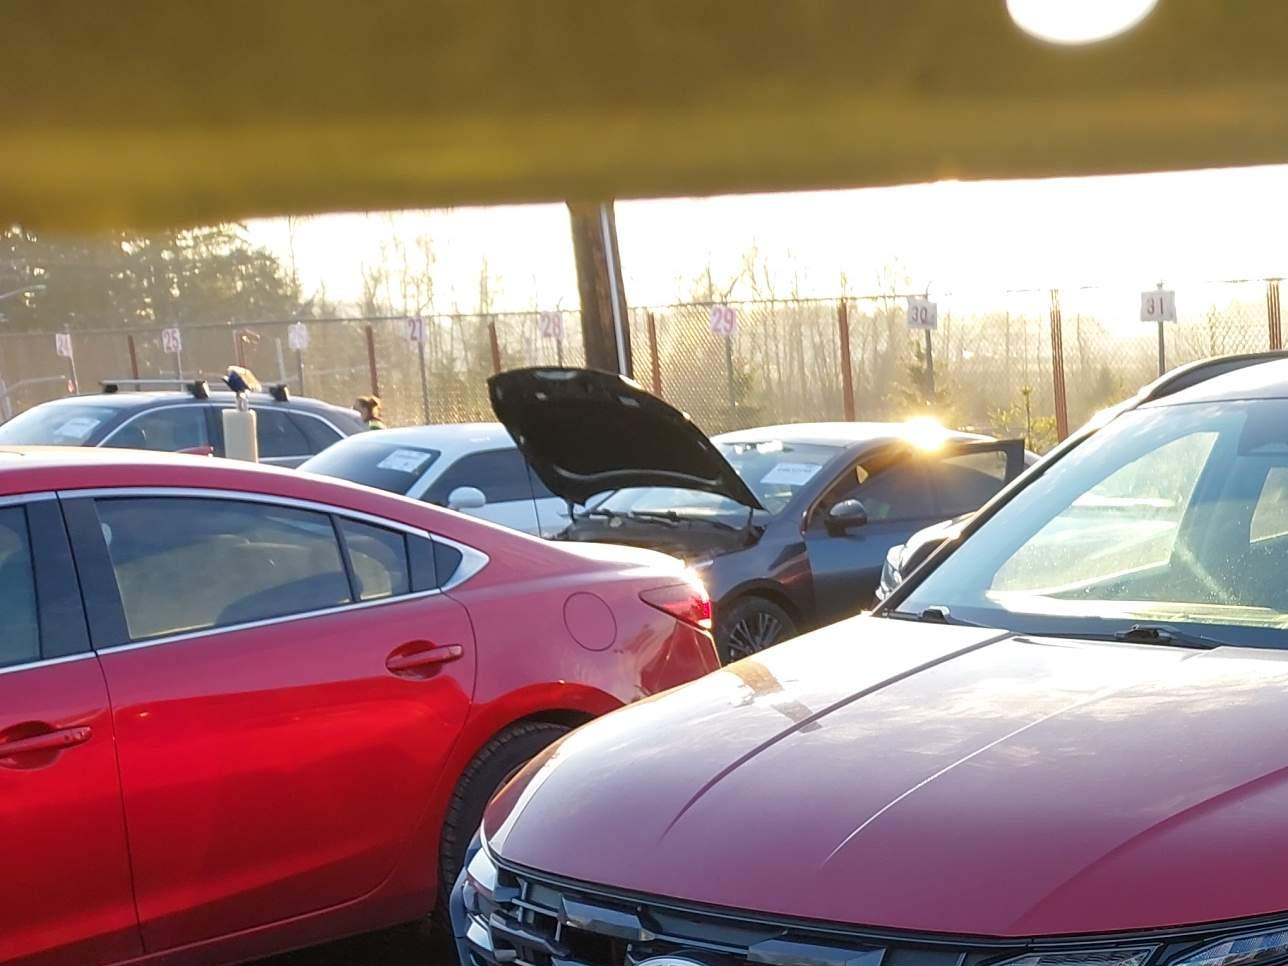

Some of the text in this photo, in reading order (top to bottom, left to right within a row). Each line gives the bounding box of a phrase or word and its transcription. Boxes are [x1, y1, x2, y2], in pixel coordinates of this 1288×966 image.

[910, 304, 929, 323] 30
[1145, 295, 1167, 316] 31
[541, 313, 561, 337] 28
[711, 307, 736, 334] 29
